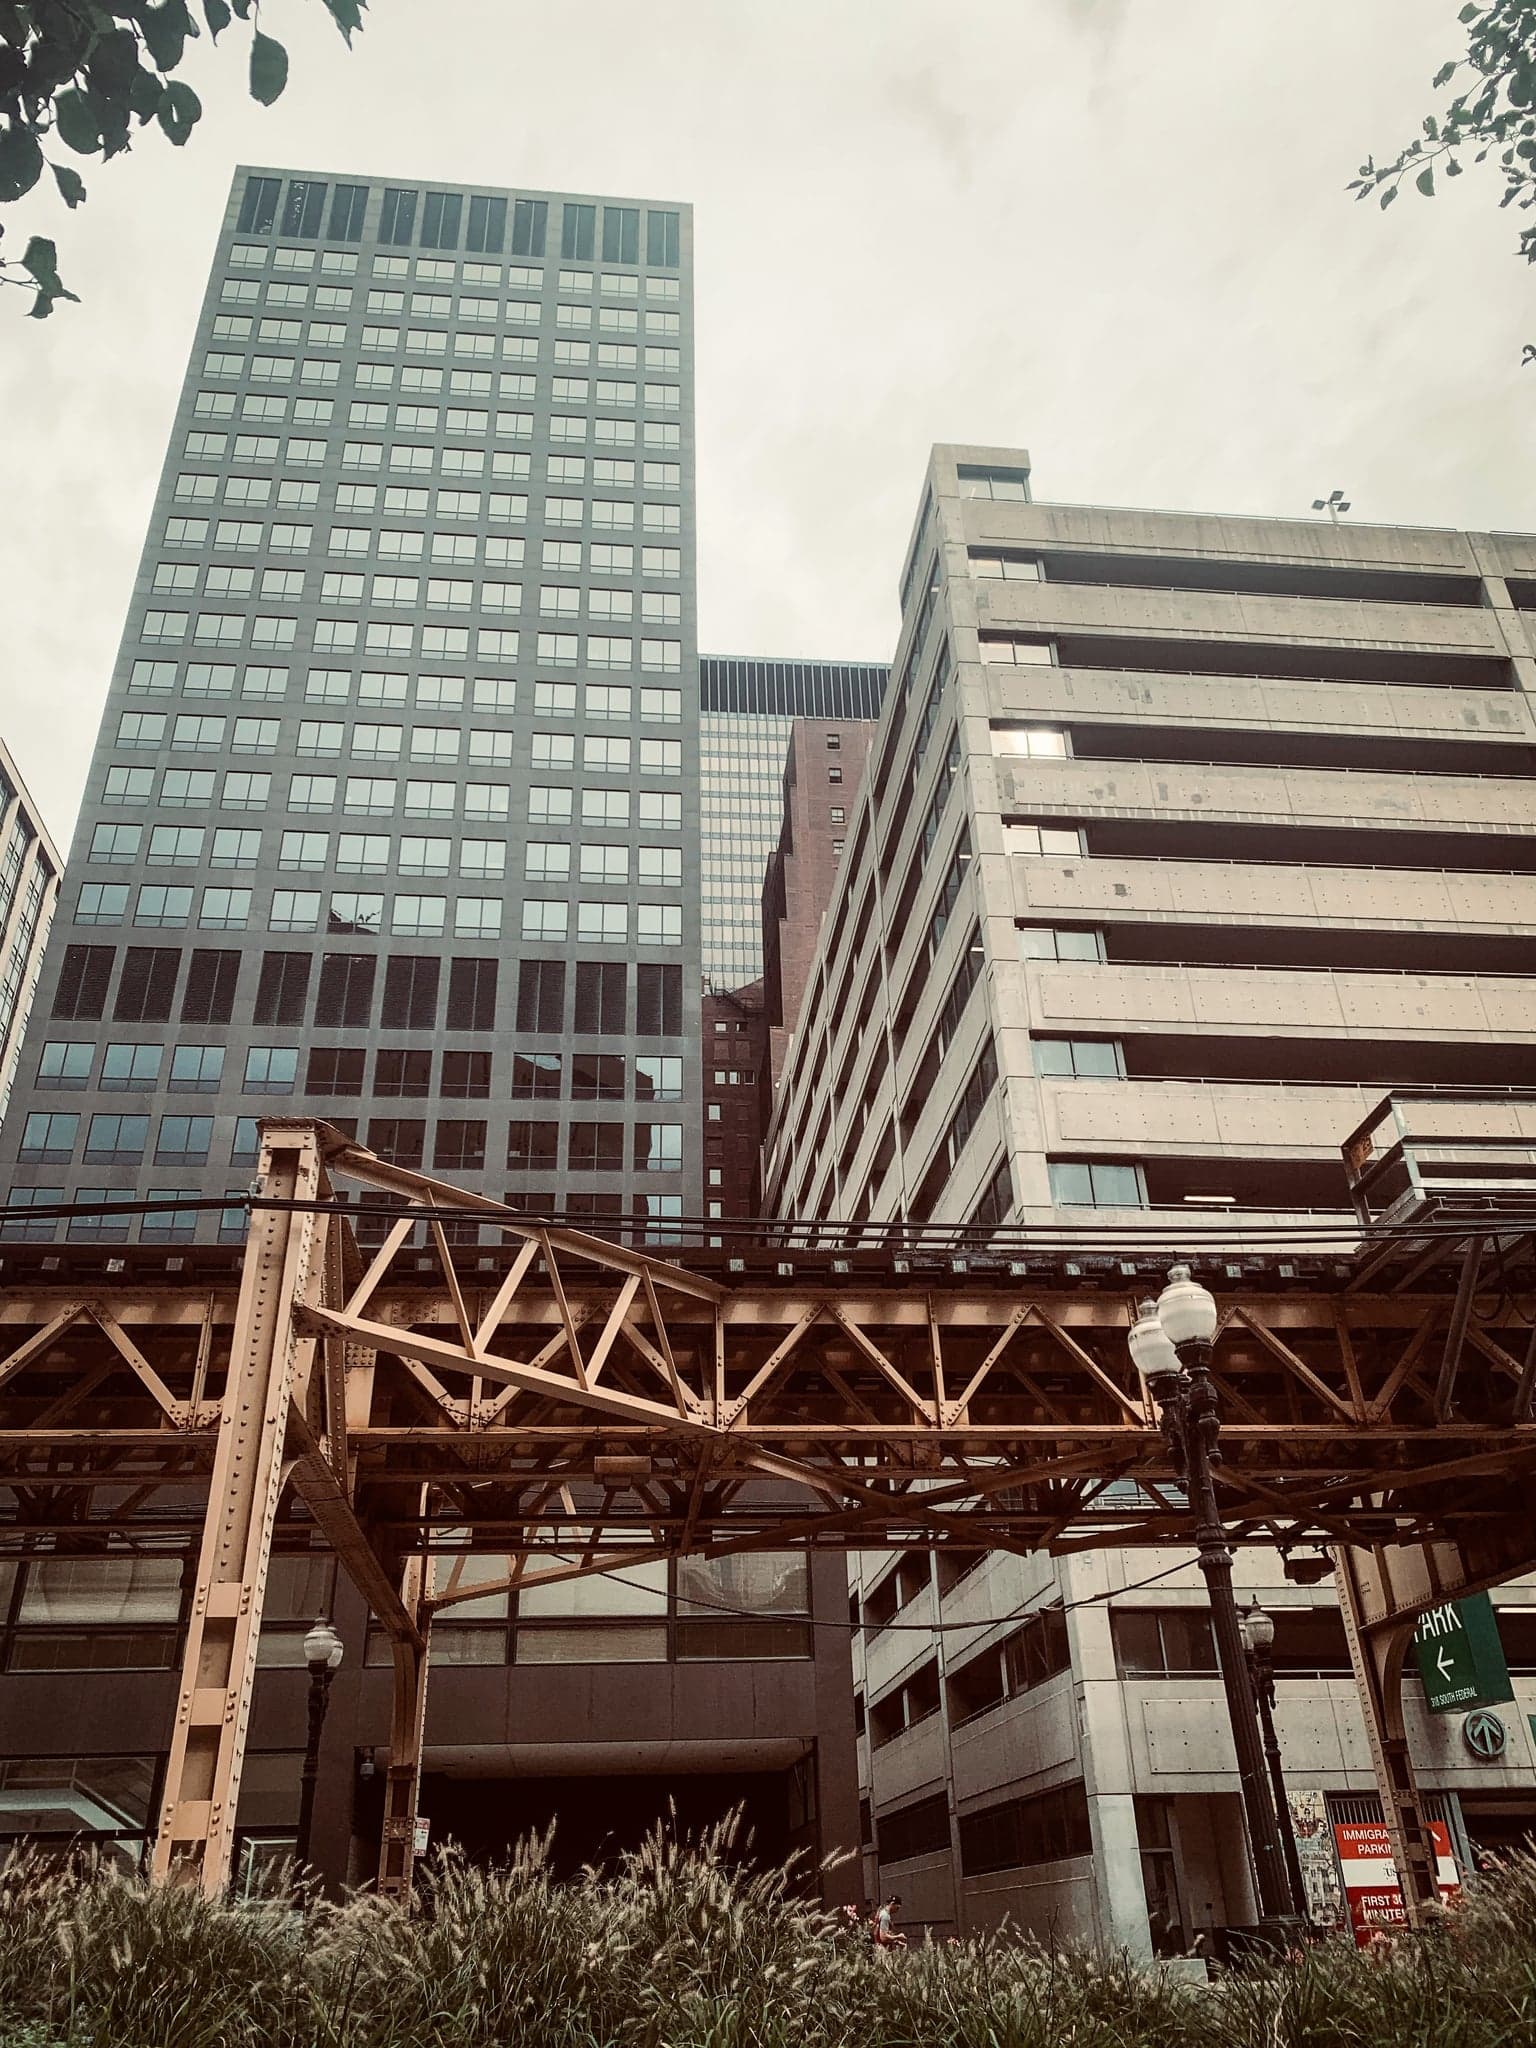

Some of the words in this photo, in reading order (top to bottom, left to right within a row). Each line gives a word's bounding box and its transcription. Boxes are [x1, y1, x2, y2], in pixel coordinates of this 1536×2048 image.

[1439, 1692, 1455, 1705] SOUTH
[1455, 1687, 1477, 1701] FEDERAL
[1361, 1895, 1390, 1906] FIRST
